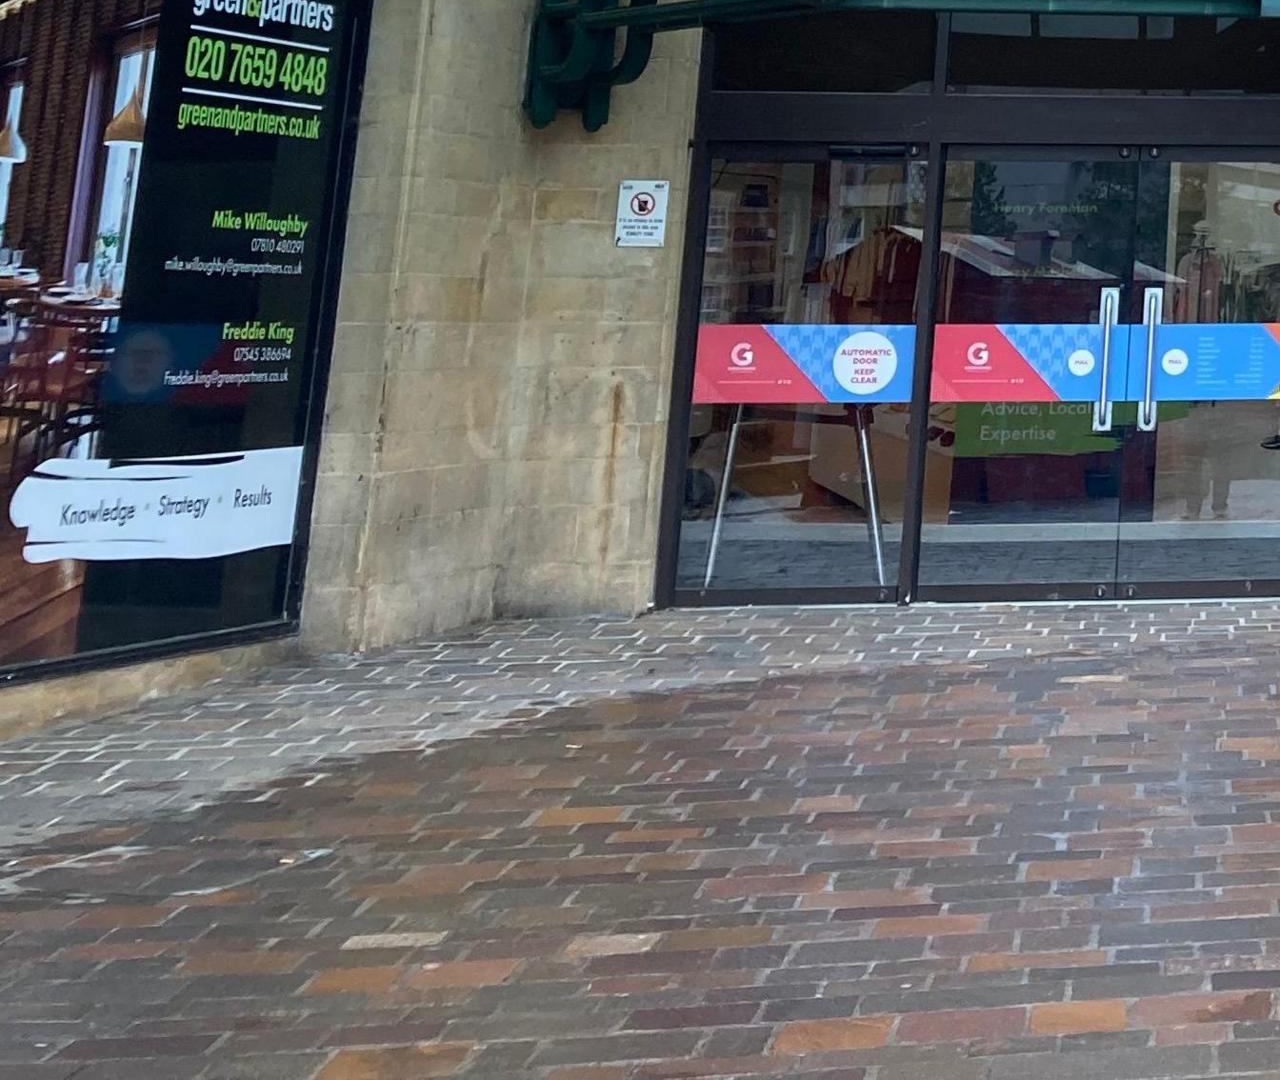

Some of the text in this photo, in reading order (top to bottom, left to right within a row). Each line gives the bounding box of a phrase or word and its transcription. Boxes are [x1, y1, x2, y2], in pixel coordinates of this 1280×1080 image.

[185, 36, 327, 95] 020 7659 4848
[177, 103, 321, 139] greenandpartners.co.uk
[212, 210, 308, 238] Mike Willoughby
[222, 321, 294, 344] Freddie King
[234, 347, 259, 362] 07545
[731, 342, 754, 366] G
[853, 357, 878, 365] DOOR
[967, 342, 989, 366] G
[1049, 403, 1091, 415] Local
[980, 426, 1056, 445] Expertise
[60, 484, 272, 527] Knowledge Strategy Results
